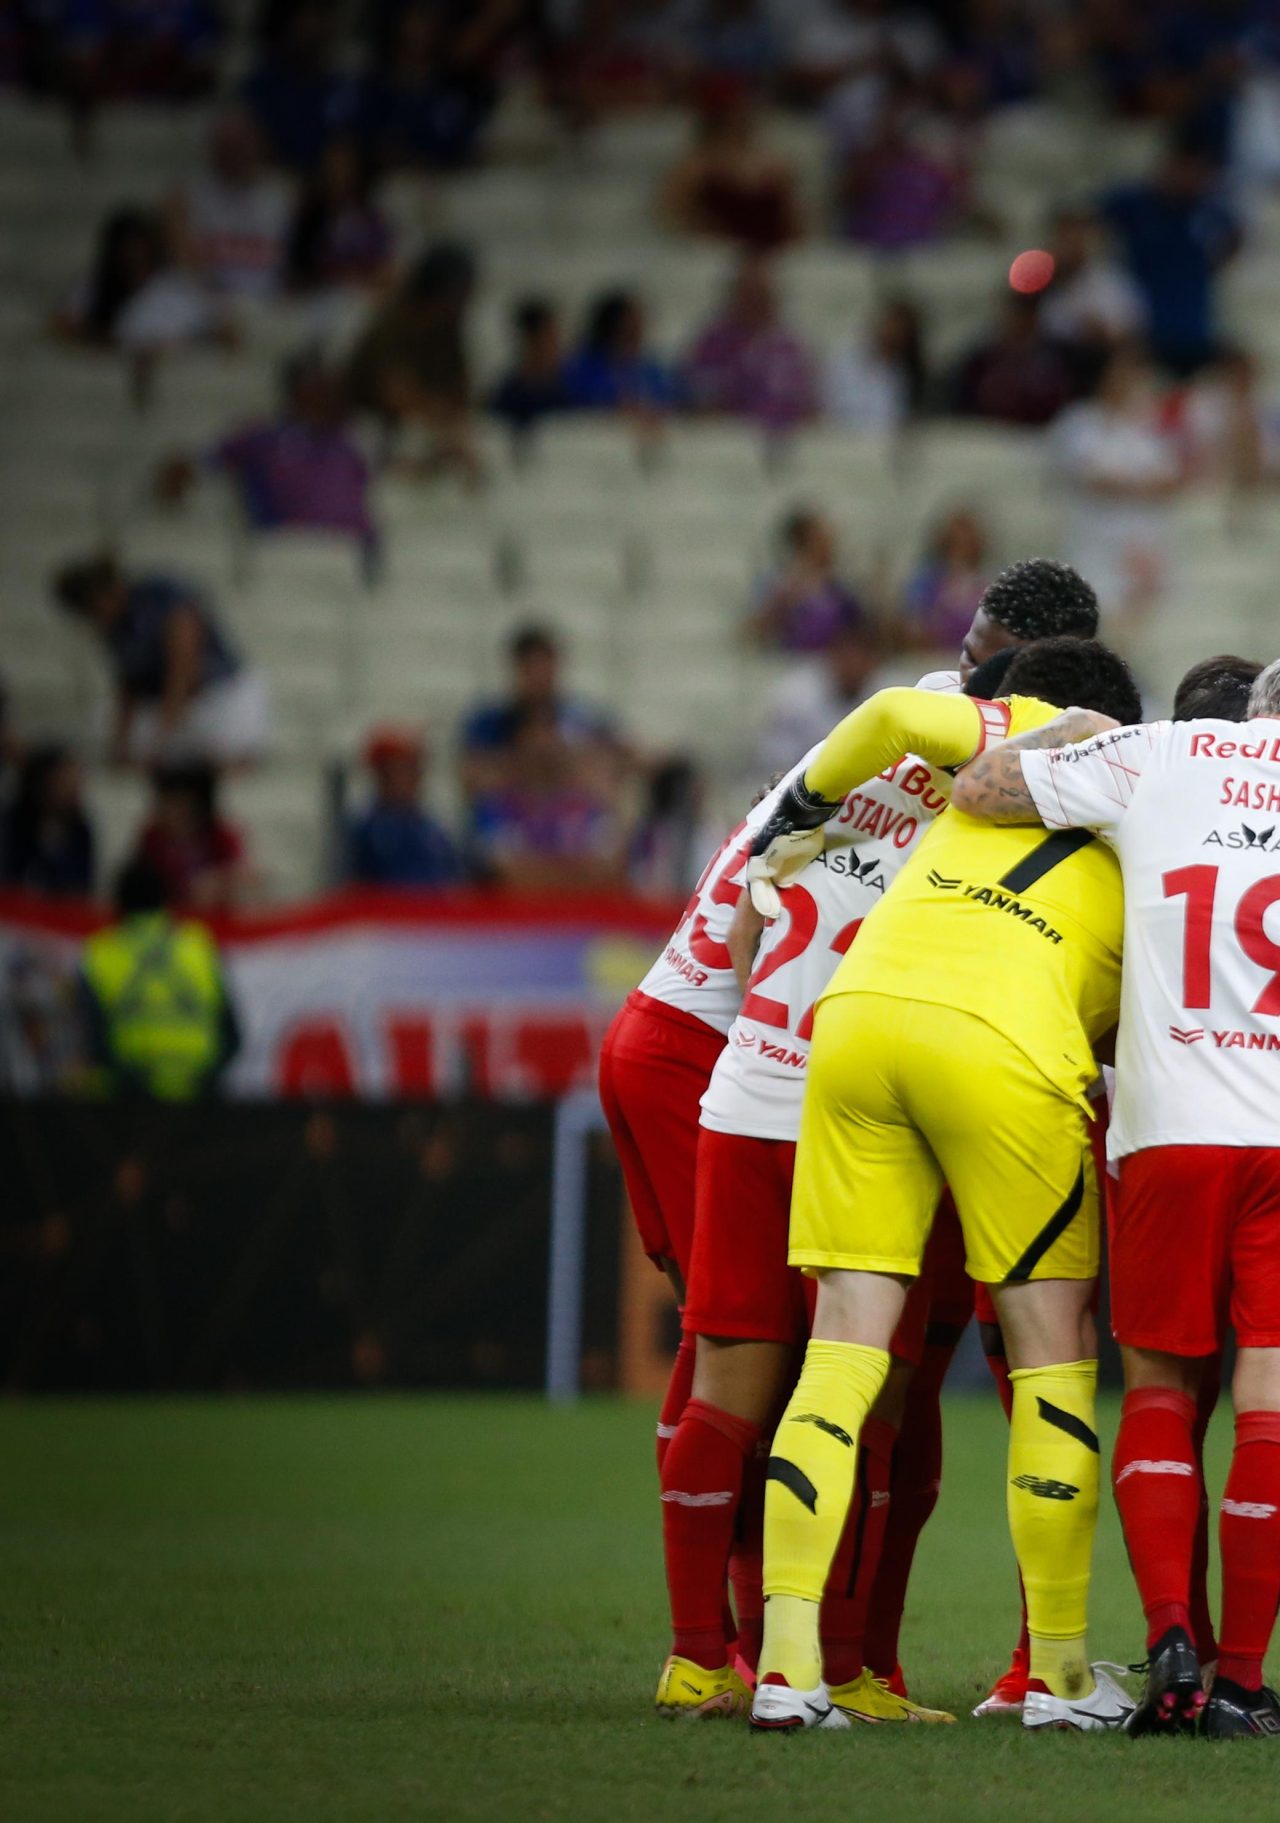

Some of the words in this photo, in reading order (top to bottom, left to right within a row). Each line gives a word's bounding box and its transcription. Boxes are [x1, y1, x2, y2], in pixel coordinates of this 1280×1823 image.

[837, 792, 918, 849] STAVO
[962, 884, 1064, 945] YANMAR
[758, 1040, 809, 1070] YAN
